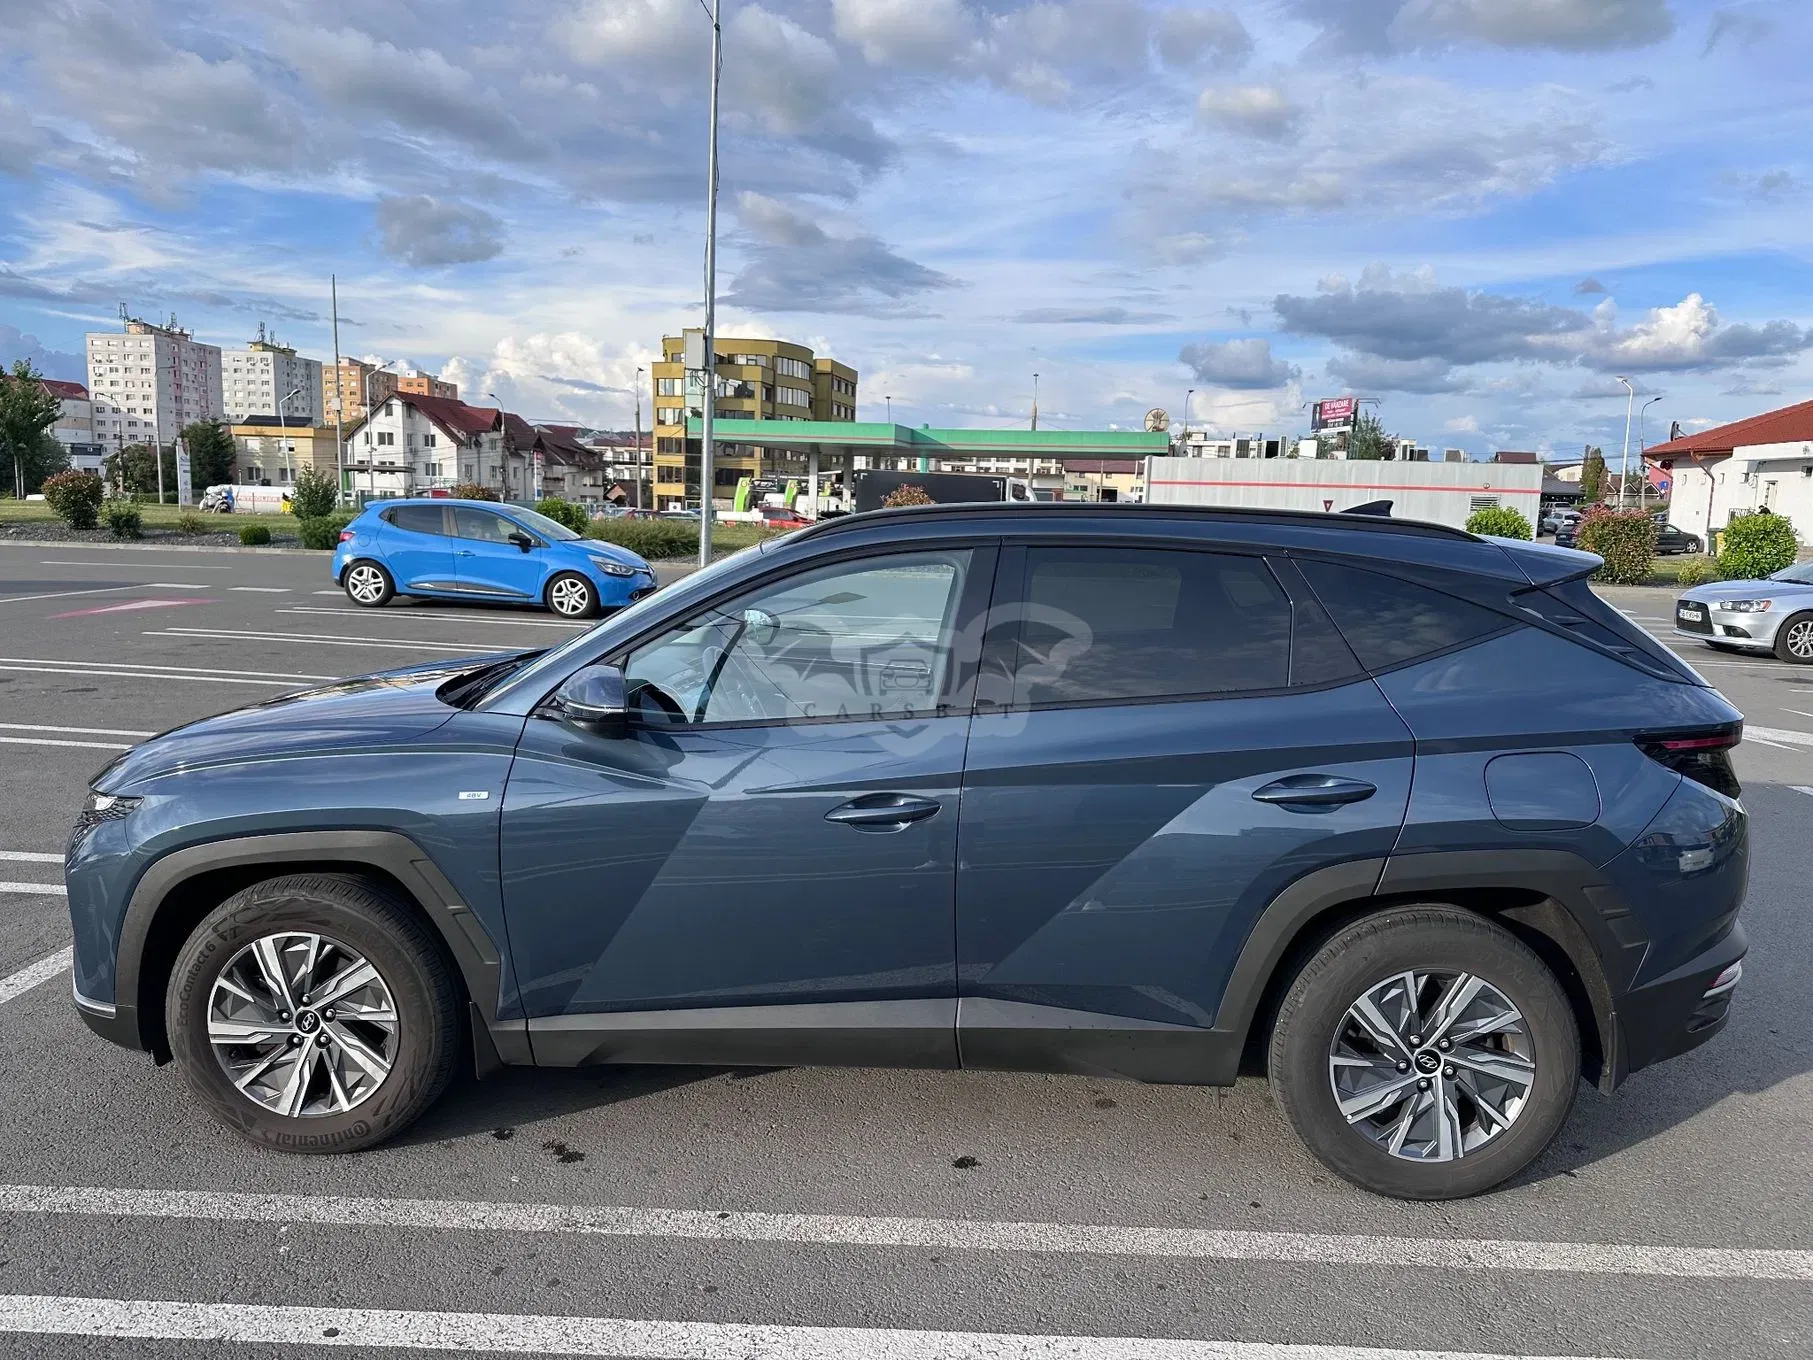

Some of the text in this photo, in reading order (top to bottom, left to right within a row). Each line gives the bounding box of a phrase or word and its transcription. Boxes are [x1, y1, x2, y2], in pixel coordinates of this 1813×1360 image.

[177, 940, 217, 1028] EcoContact 6
[276, 1119, 372, 1148] Continental
